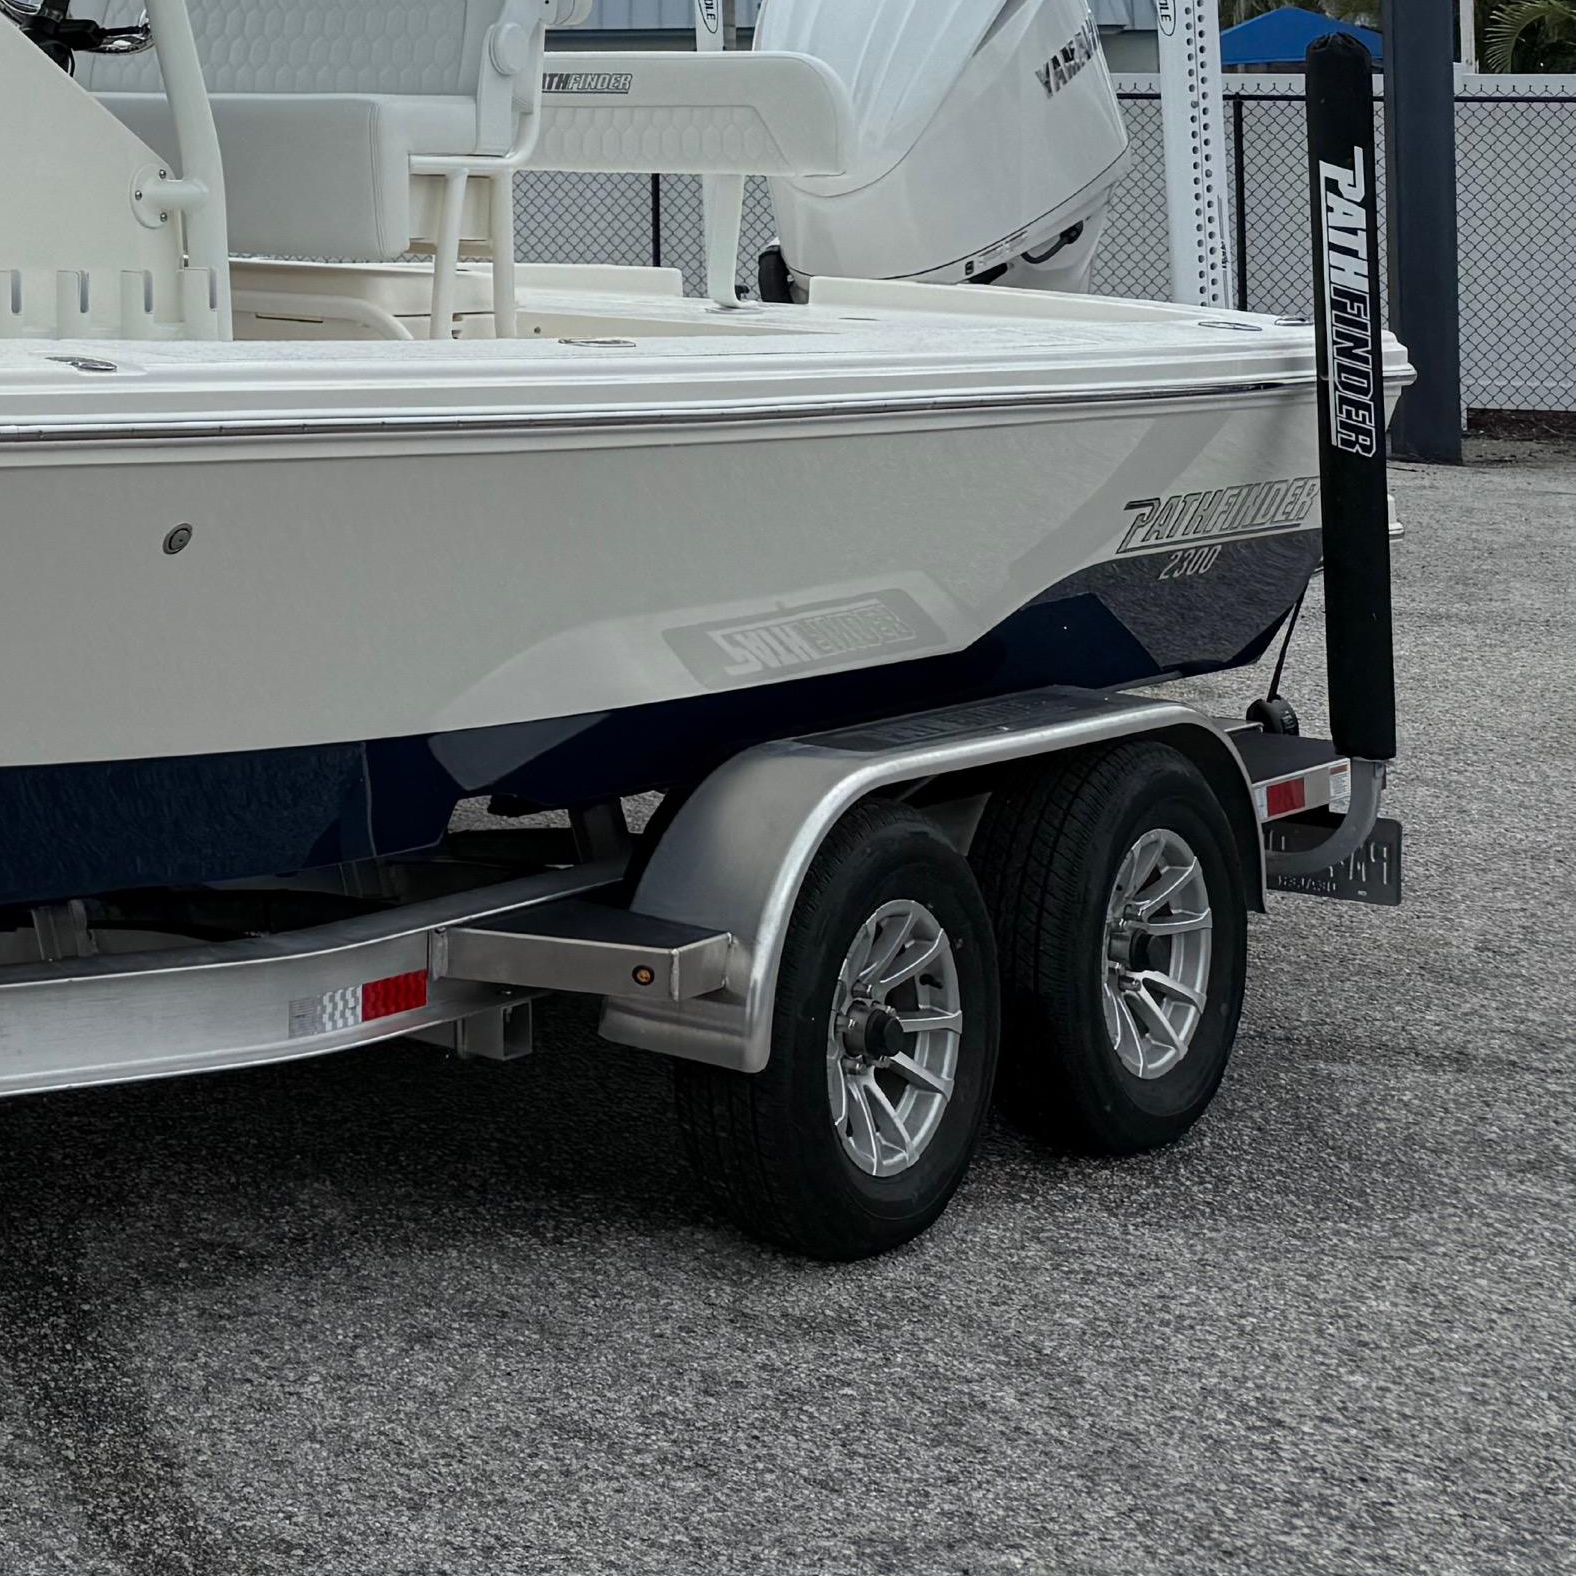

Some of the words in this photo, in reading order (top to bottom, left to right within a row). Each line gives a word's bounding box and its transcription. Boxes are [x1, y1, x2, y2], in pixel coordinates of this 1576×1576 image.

[1319, 145, 1377, 458] PATHFINDER
[1116, 475, 1321, 554] PATHFINDER
[1158, 545, 1223, 580] 2300
